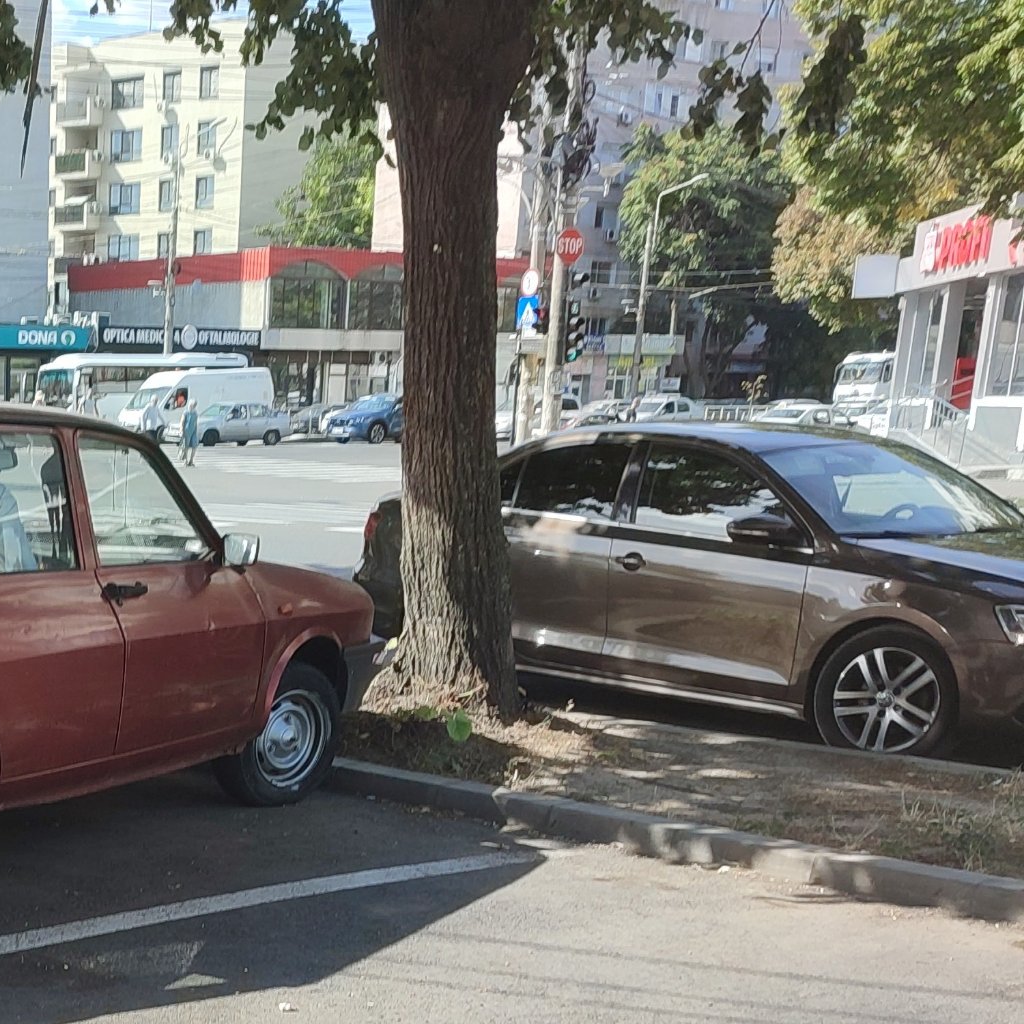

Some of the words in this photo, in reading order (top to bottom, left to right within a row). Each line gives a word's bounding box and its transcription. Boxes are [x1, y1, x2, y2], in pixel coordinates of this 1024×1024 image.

[558, 238, 582, 254] STOP
[18, 329, 57, 345] DONA
[103, 328, 136, 344] OPTICA
